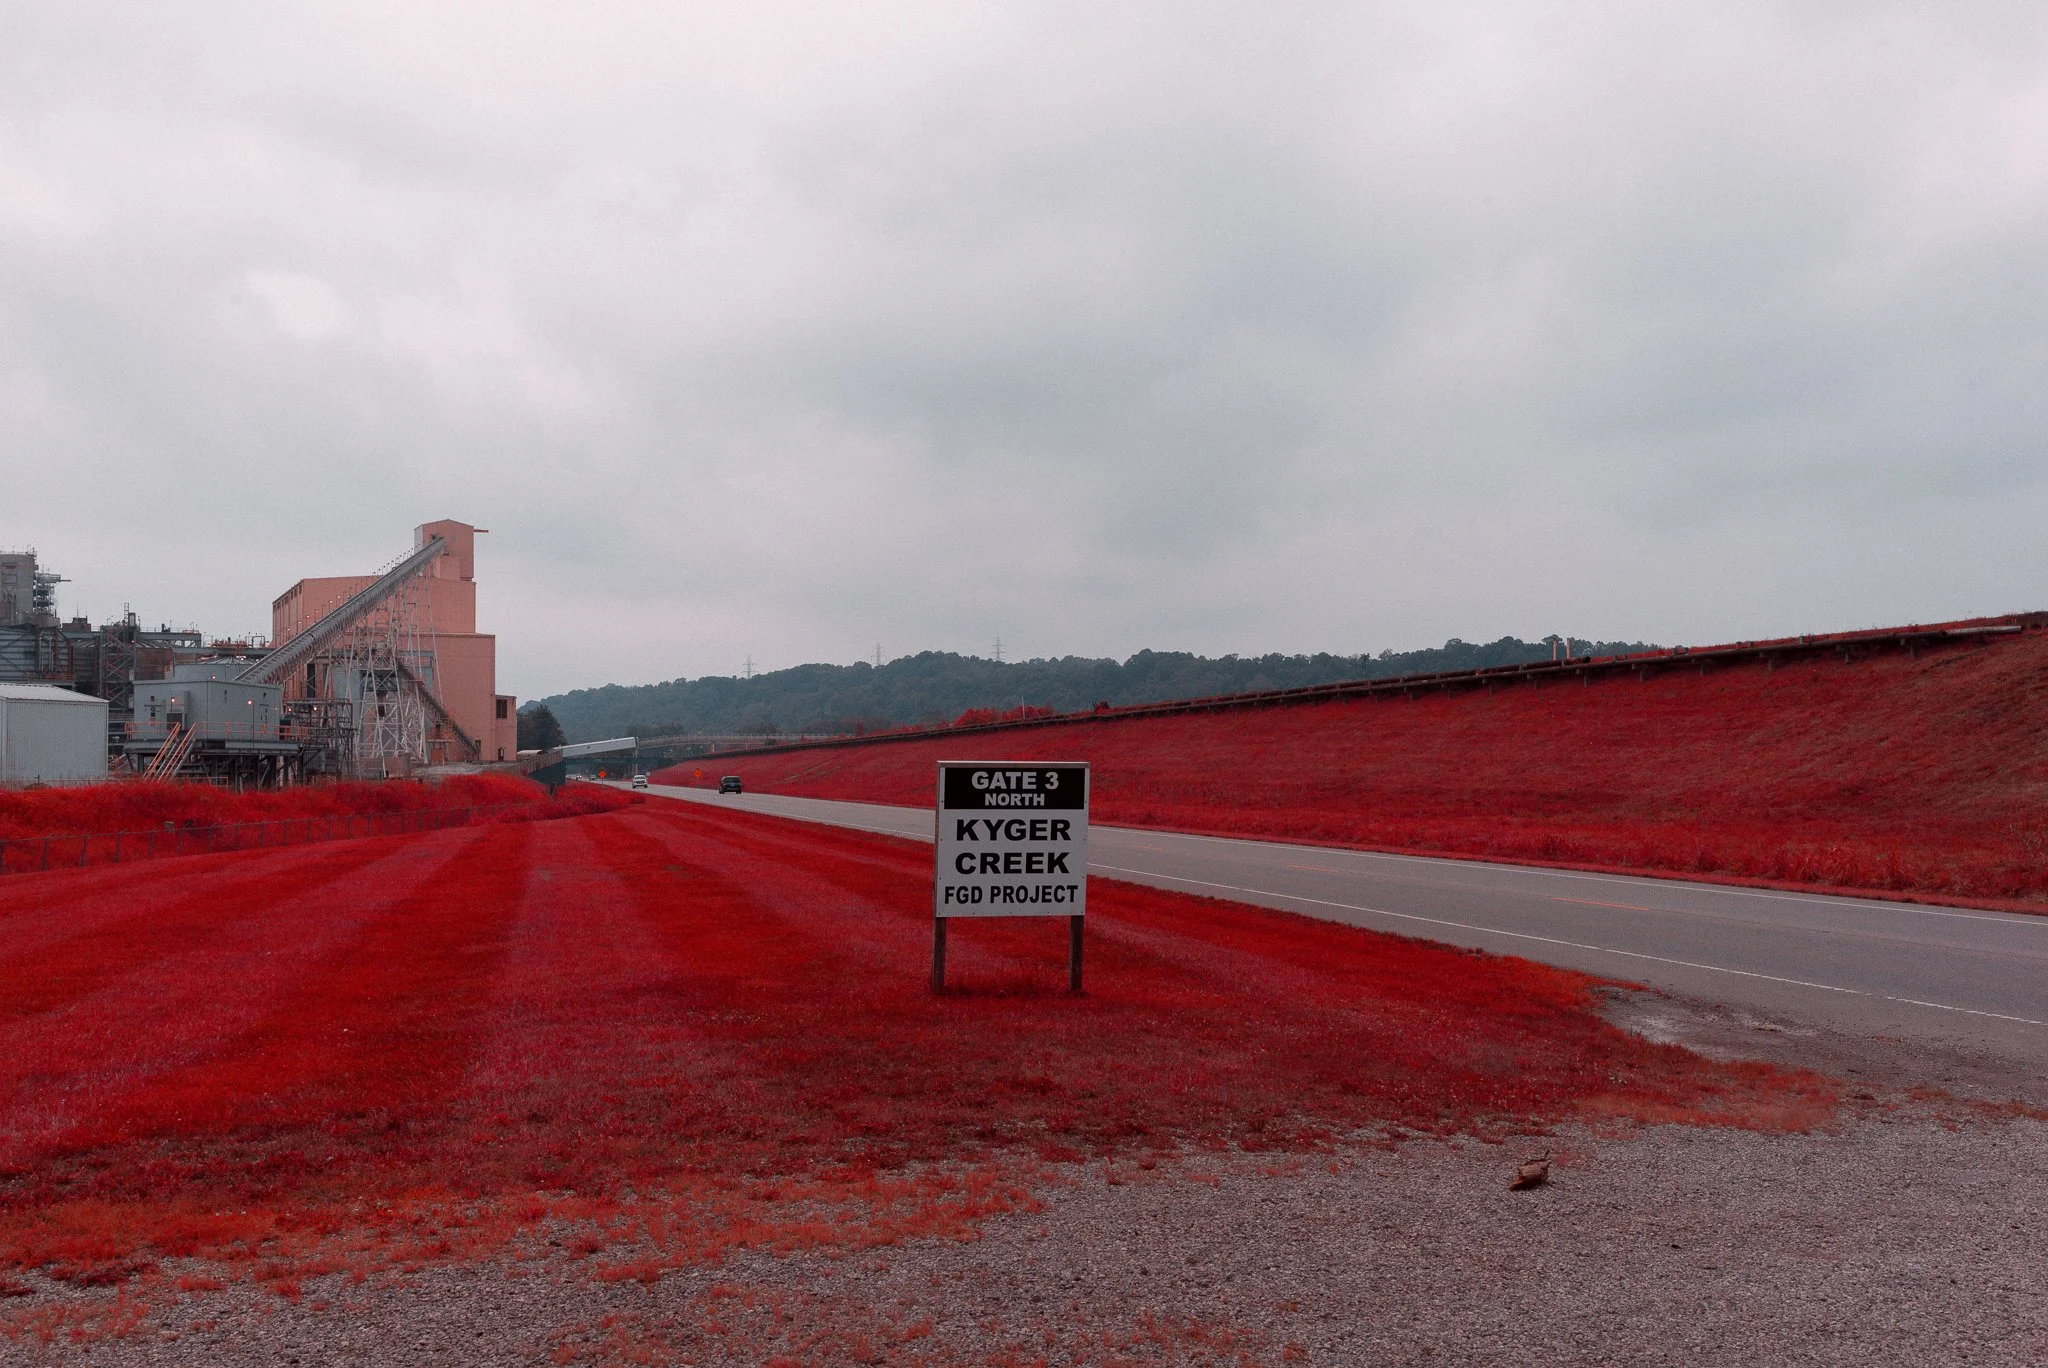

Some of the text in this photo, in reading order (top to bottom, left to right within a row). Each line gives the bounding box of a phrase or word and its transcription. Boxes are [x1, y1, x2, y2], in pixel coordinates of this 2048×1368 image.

[972, 771, 1059, 789] GATE 3
[985, 793, 1045, 806] NORTH
[956, 819, 1071, 841] KYGER
[955, 852, 1070, 874] CREEK
[944, 885, 1078, 904] FGD PROJECT
